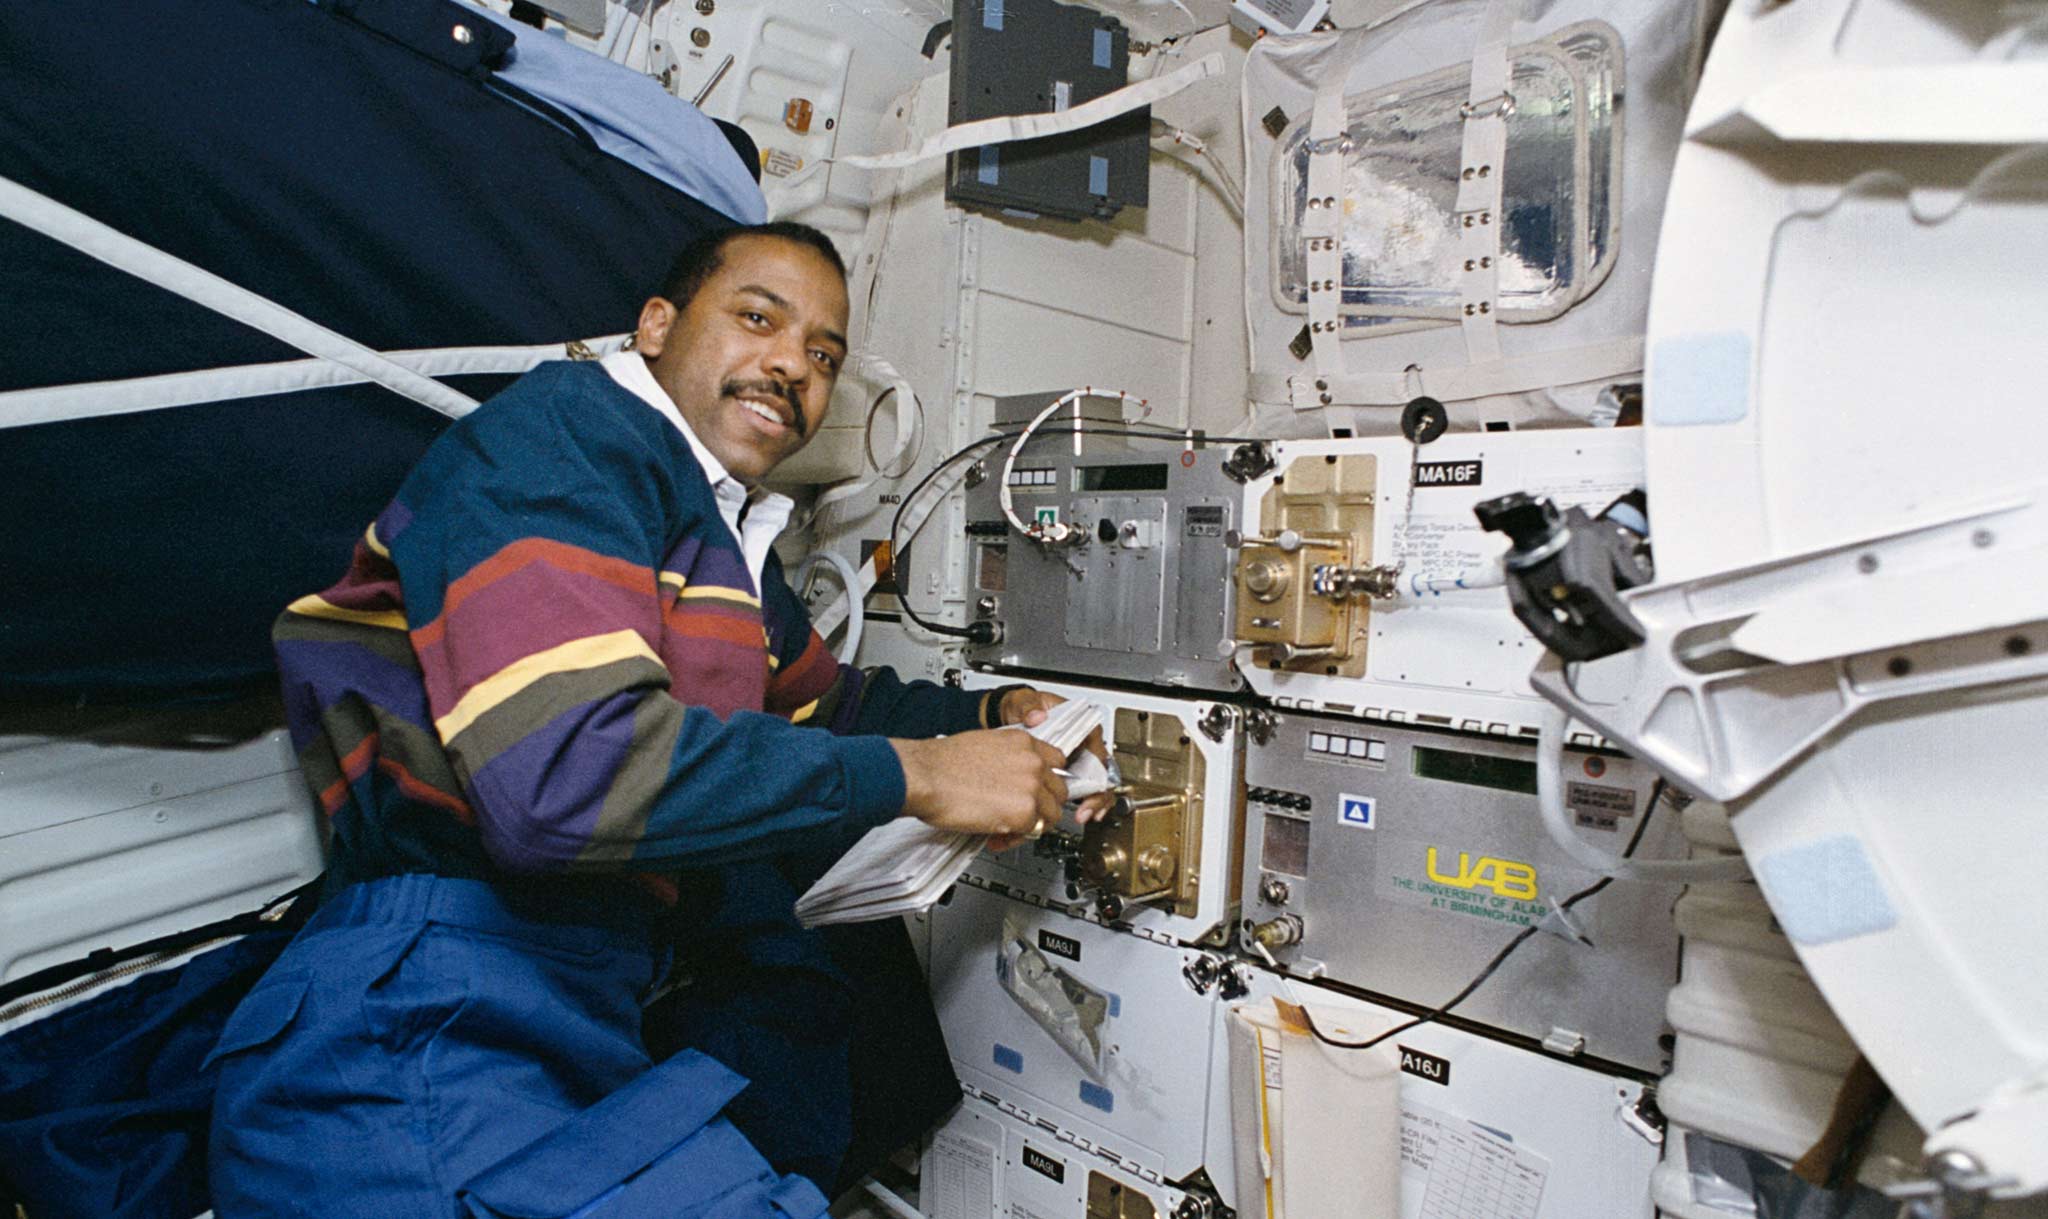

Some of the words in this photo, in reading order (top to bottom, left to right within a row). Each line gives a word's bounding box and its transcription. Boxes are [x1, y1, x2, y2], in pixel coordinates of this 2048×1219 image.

[1418, 464, 1477, 483] MA16F
[1426, 846, 1538, 902] UAB
[1392, 876, 1413, 890] THE
[1417, 882, 1487, 904] UNIVERSITY
[1490, 896, 1510, 908] OF
[1431, 898, 1446, 908] AT
[1450, 901, 1532, 926] BIRMINGHAM
[1046, 935, 1073, 955] MA9J
[1399, 1051, 1441, 1078] A16J
[1030, 1153, 1057, 1176] MA9L
